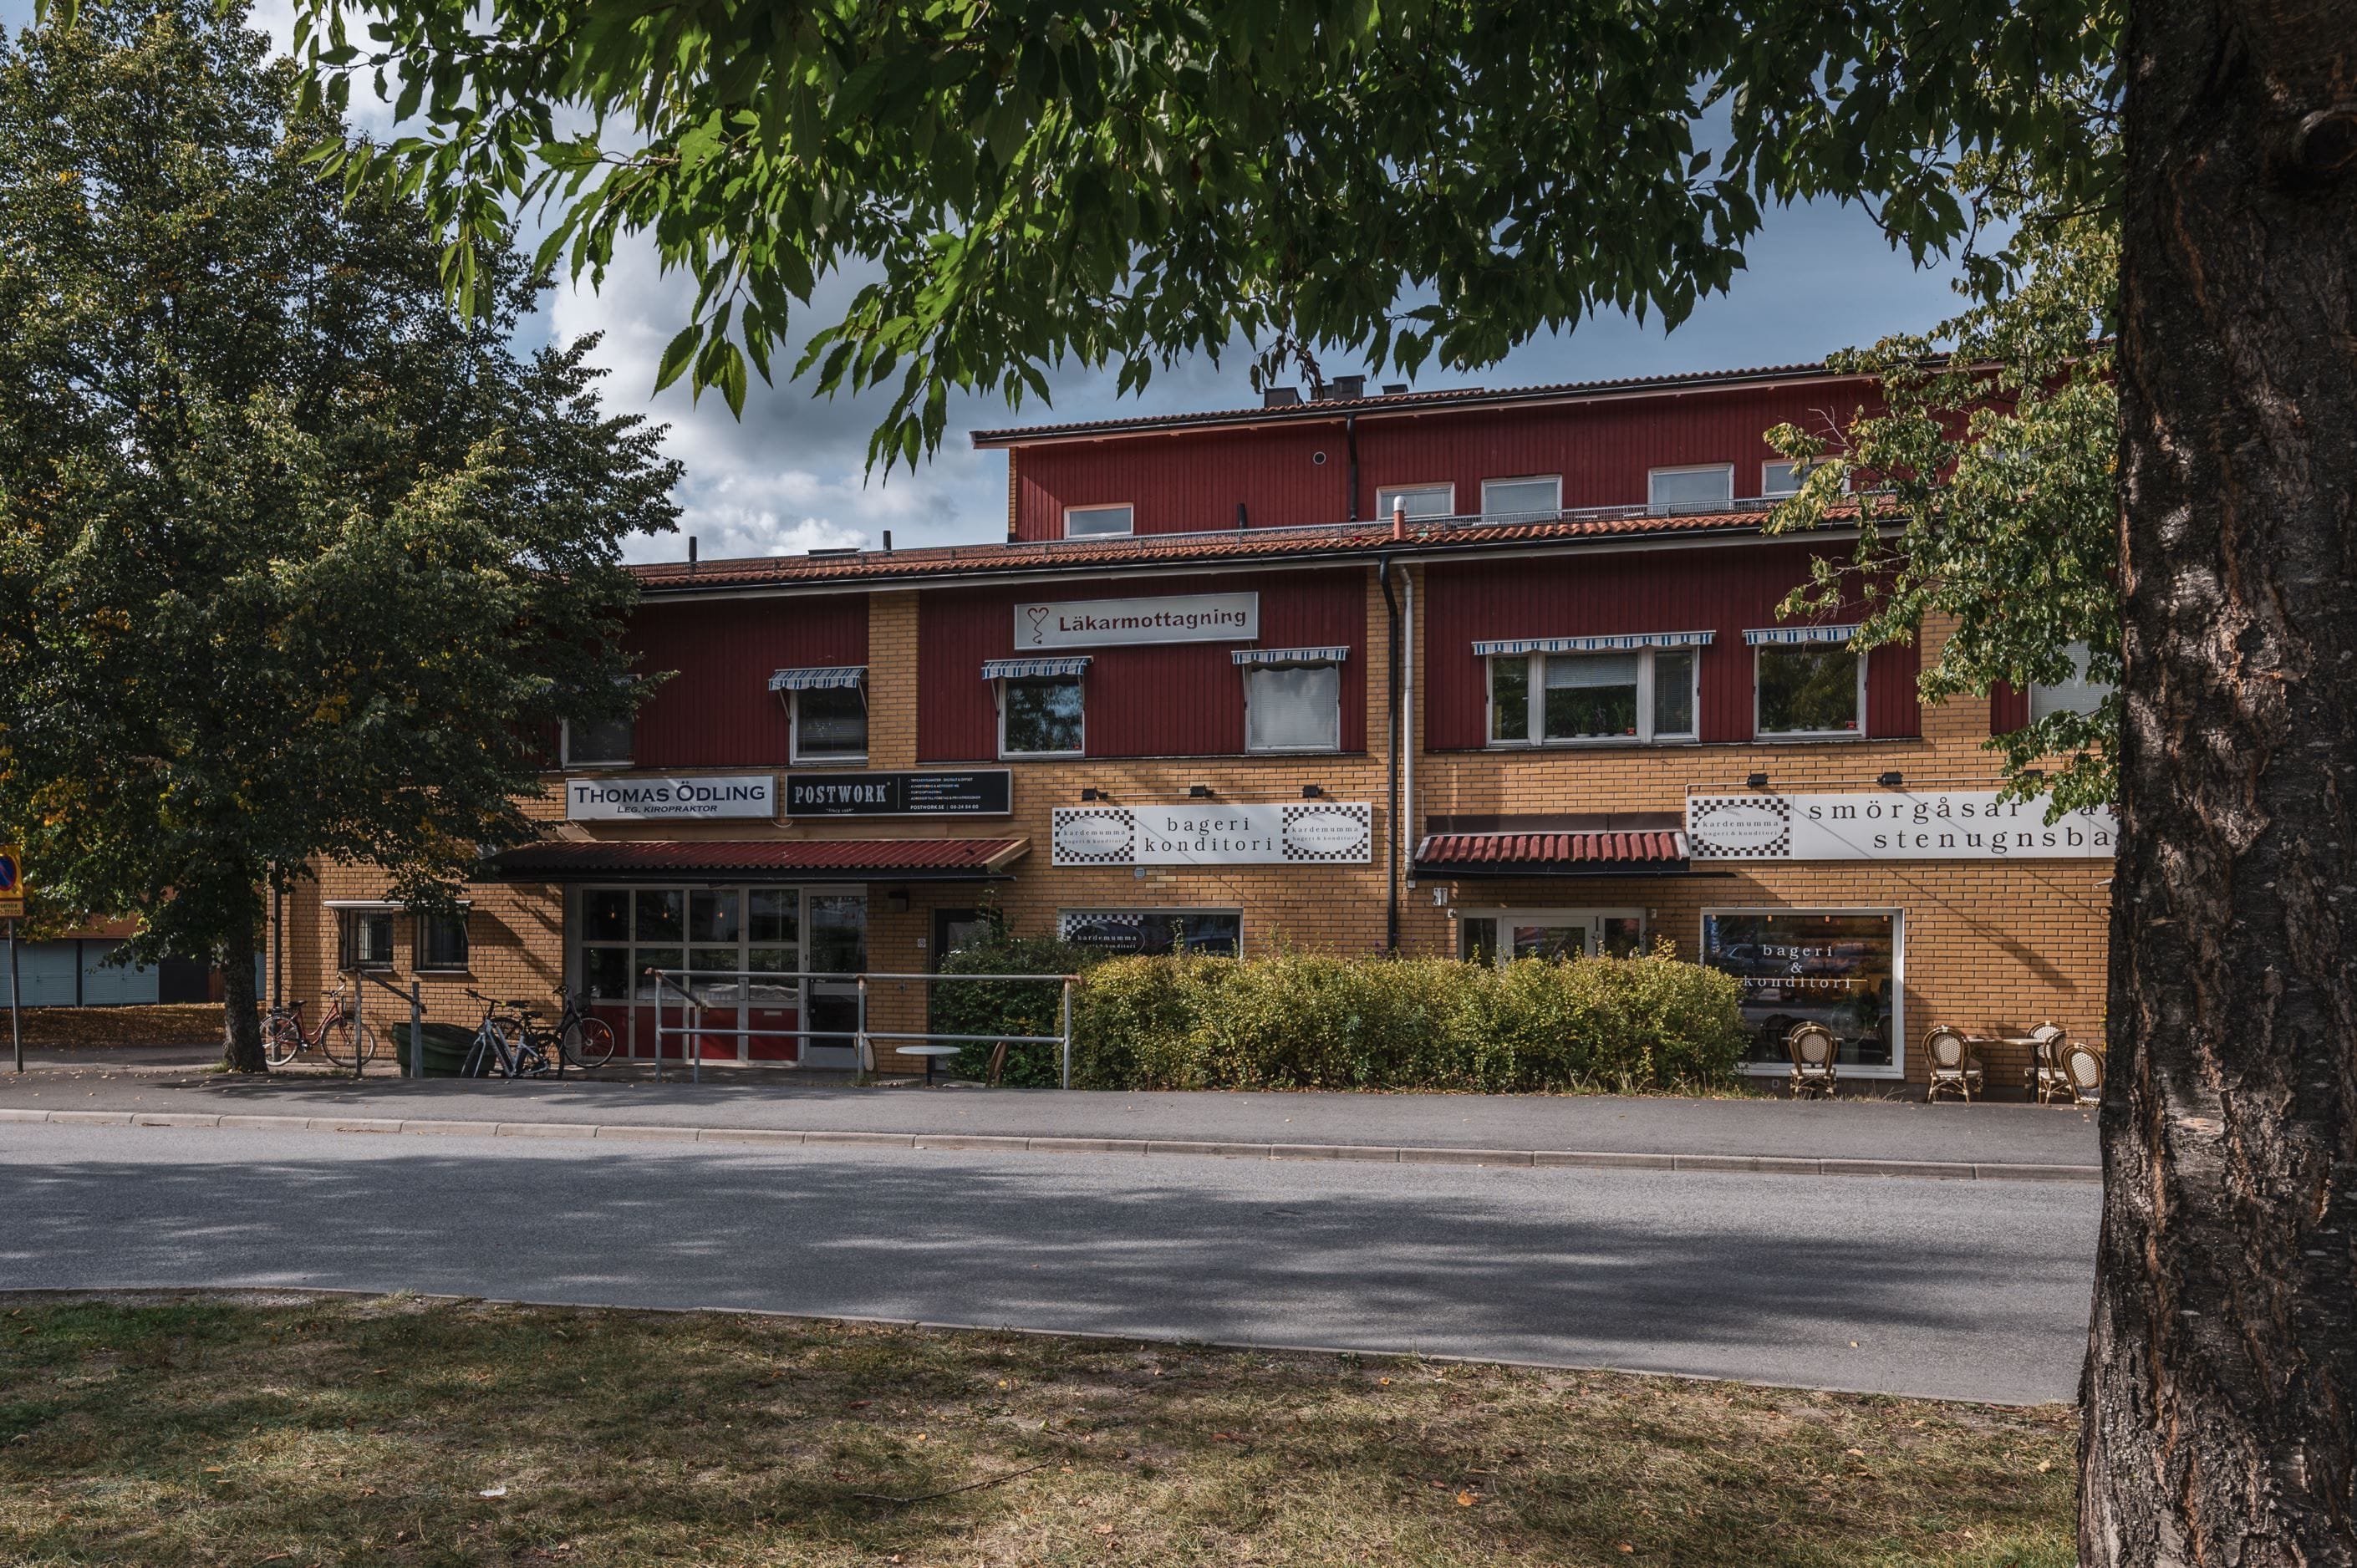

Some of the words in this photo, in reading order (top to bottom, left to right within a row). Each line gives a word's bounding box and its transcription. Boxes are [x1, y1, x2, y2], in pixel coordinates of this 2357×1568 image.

[1059, 608, 1246, 632] Läkarmottagning
[573, 786, 669, 803] THOMAS
[675, 781, 766, 802] ÖDLING
[794, 784, 886, 803] POSTWORK
[617, 805, 642, 814] LEG.
[643, 805, 718, 813] KIROPRAKTOR
[1809, 797, 2022, 825] smörgåsar
[1167, 817, 1250, 837] bageri
[1144, 837, 1272, 853] konditori
[1874, 827, 2110, 854] stenugnsba
[1763, 944, 1833, 960] bageri
[1790, 961, 1803, 974] &
[1744, 975, 1851, 989] konditori
